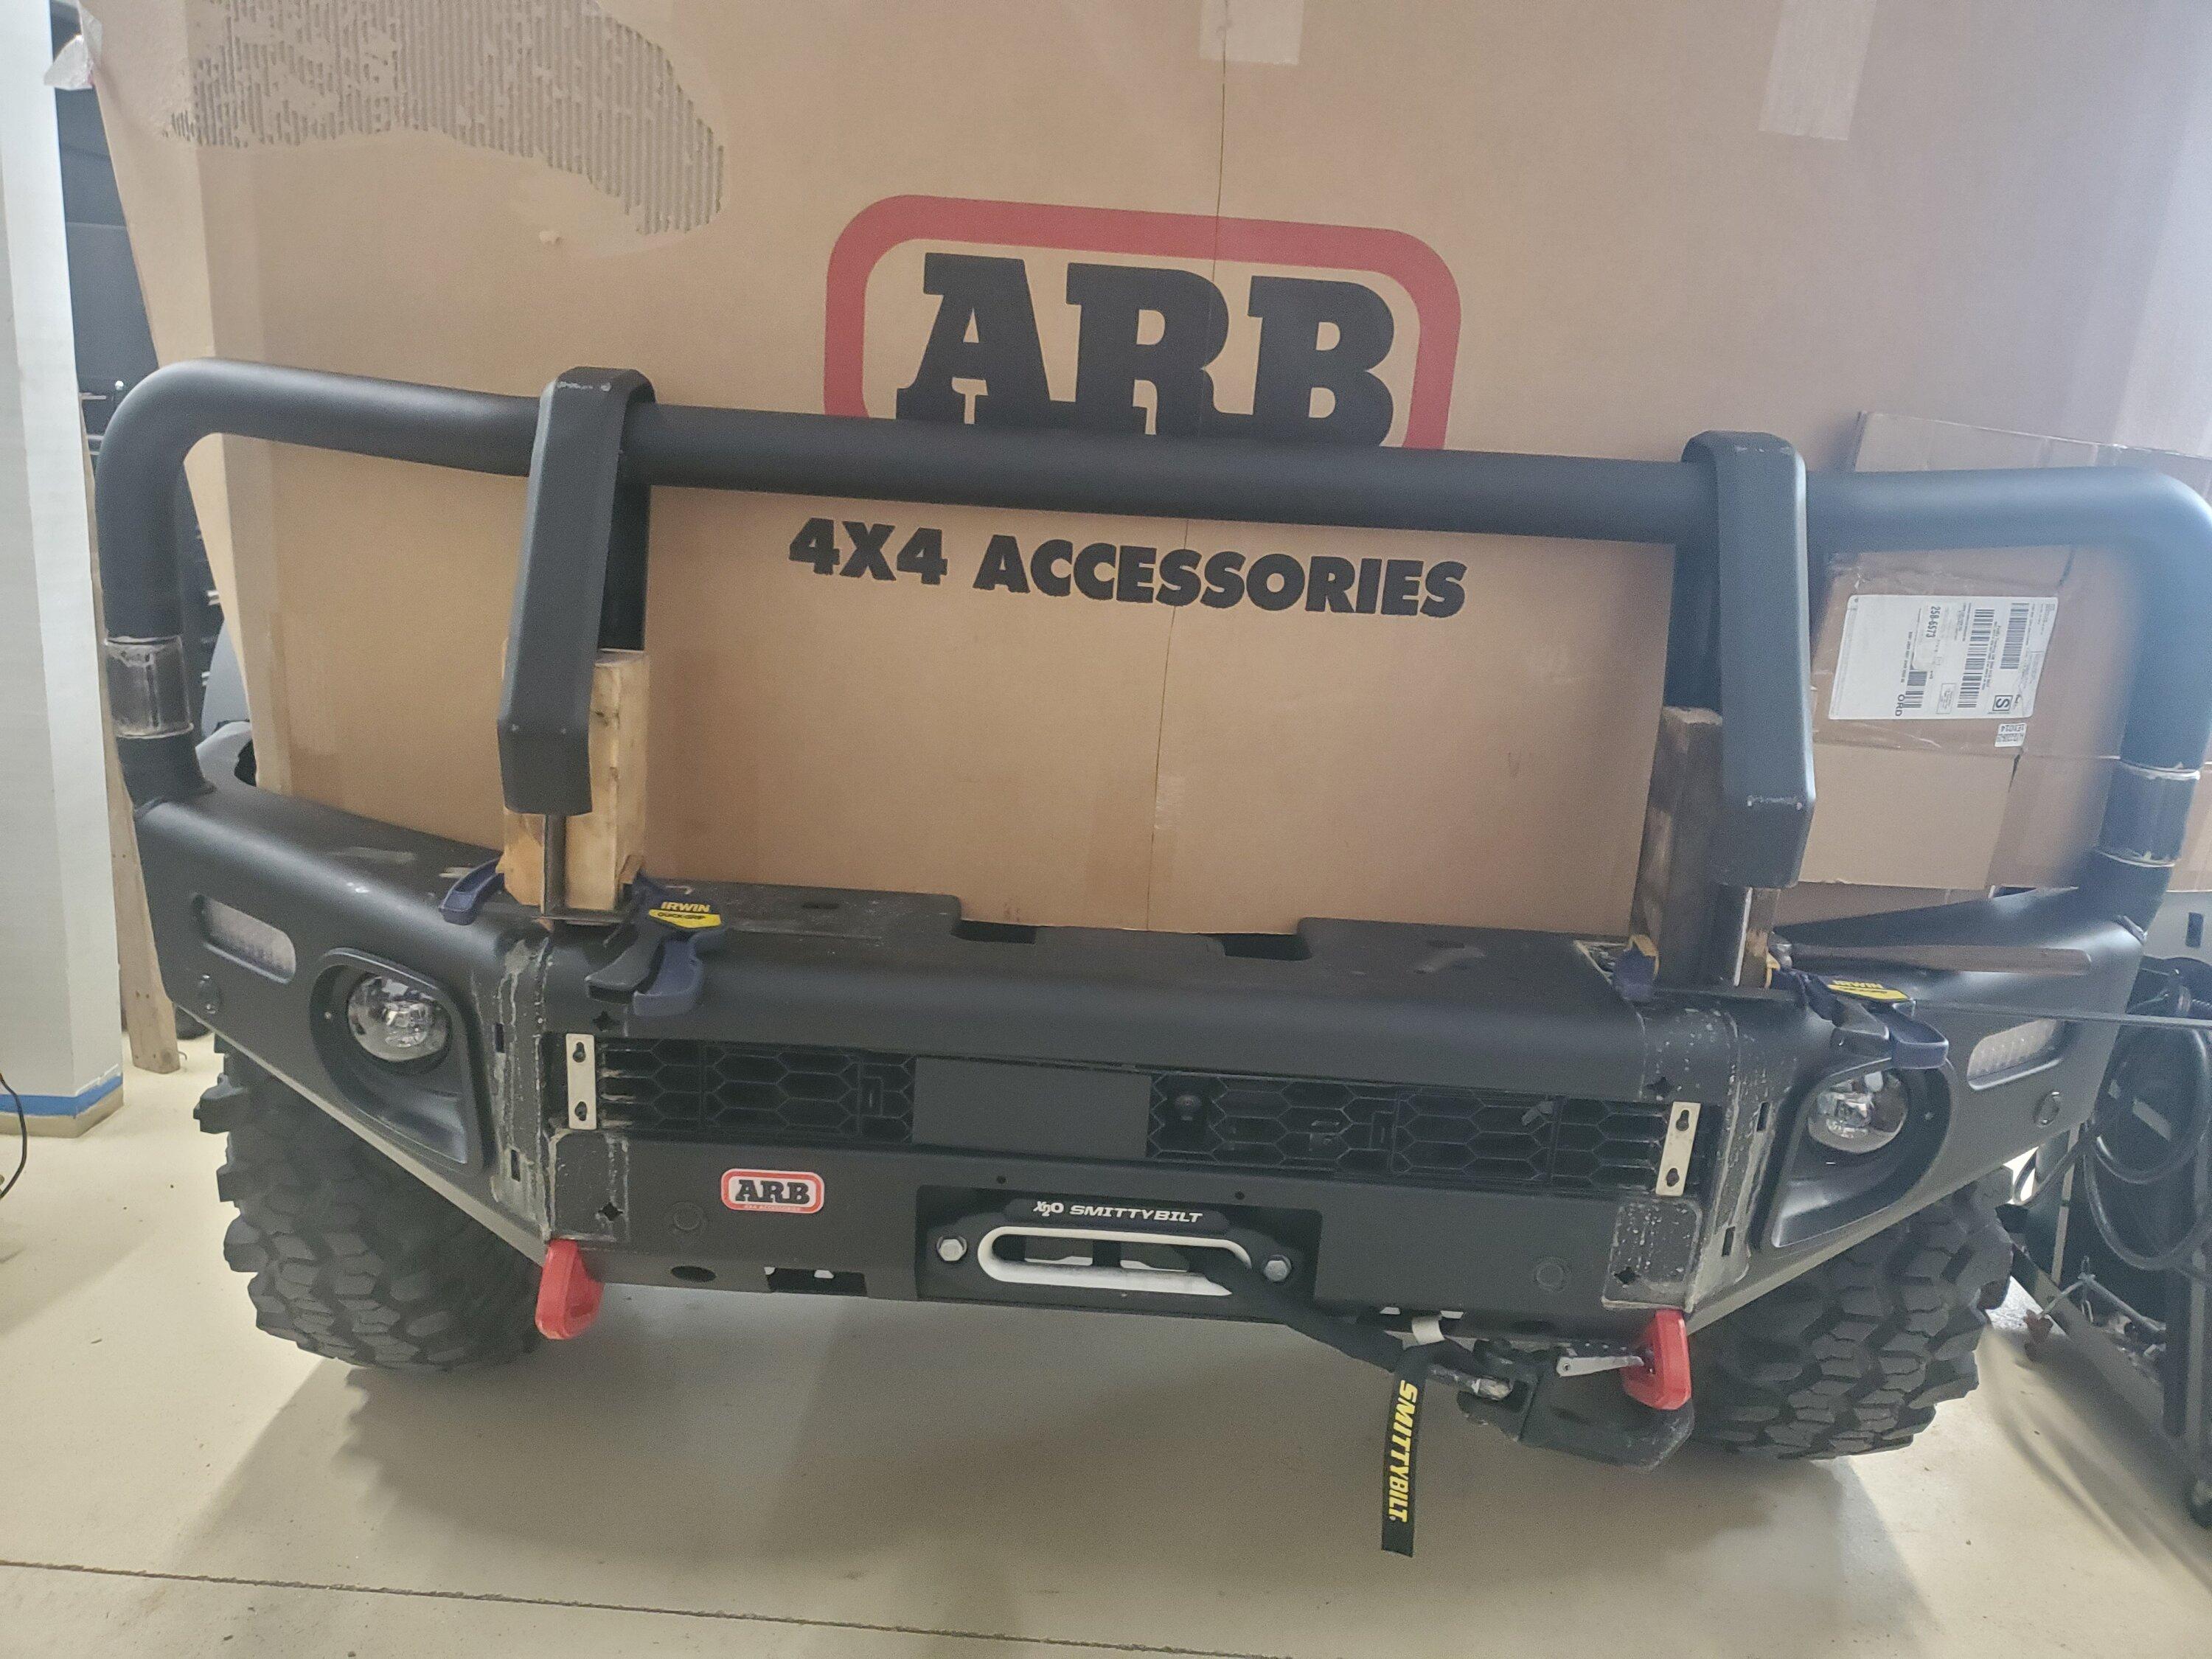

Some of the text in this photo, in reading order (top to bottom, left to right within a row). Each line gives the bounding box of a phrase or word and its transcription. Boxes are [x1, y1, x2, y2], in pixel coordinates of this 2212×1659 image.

[897, 252, 1395, 447] ARB
[789, 518, 1467, 618] 4X4 ACCESSORIES
[1895, 694, 1905, 717] ORD
[1996, 698, 2010, 708] S
[661, 902, 711, 912] IRWIN
[735, 1179, 810, 1205] ARB
[1069, 1205, 1203, 1222] SMITTYBILT
[1388, 1380, 1418, 1522] SMITTYBILT
